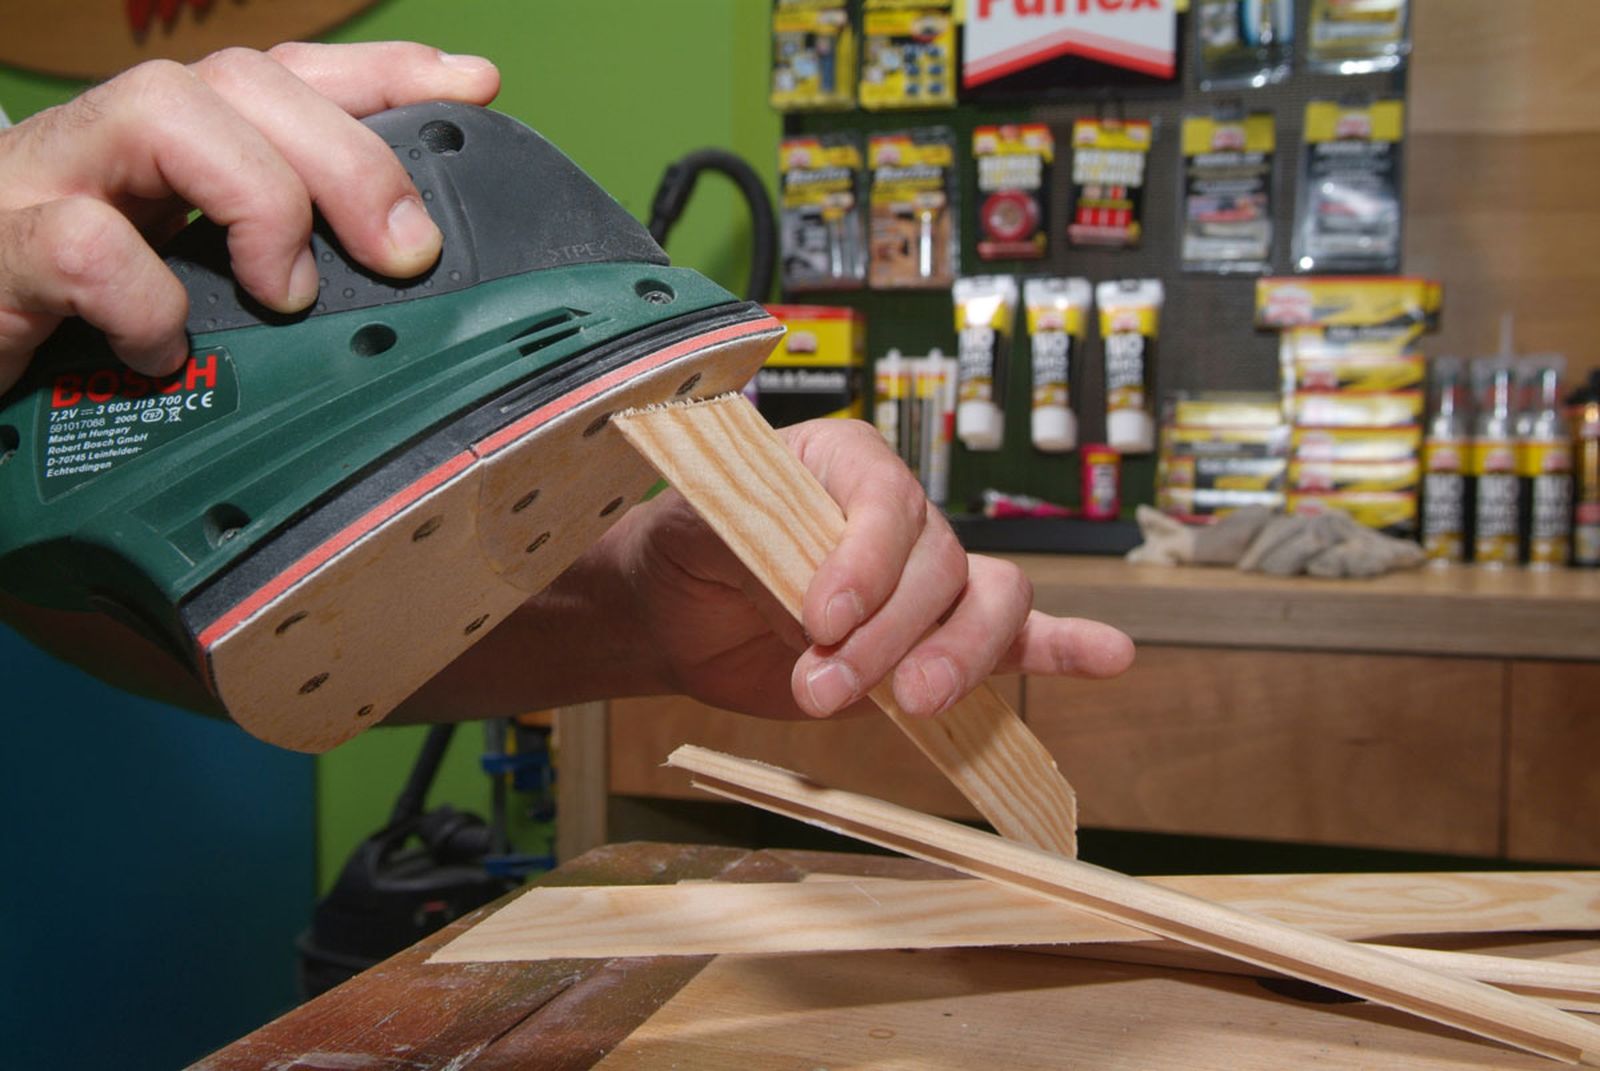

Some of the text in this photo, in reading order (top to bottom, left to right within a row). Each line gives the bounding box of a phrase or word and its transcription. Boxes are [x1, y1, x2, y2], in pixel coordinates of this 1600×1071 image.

[49, 408, 79, 422] 7,2V
[96, 404, 105, 415] 3
[107, 401, 131, 414] 603
[158, 394, 182, 407] 700
[47, 432, 149, 455] Robert Bosch GmbH
[48, 426, 132, 444] Made in Hungary
[46, 452, 86, 467] D-70745
[46, 461, 112, 478] Echterdingen
